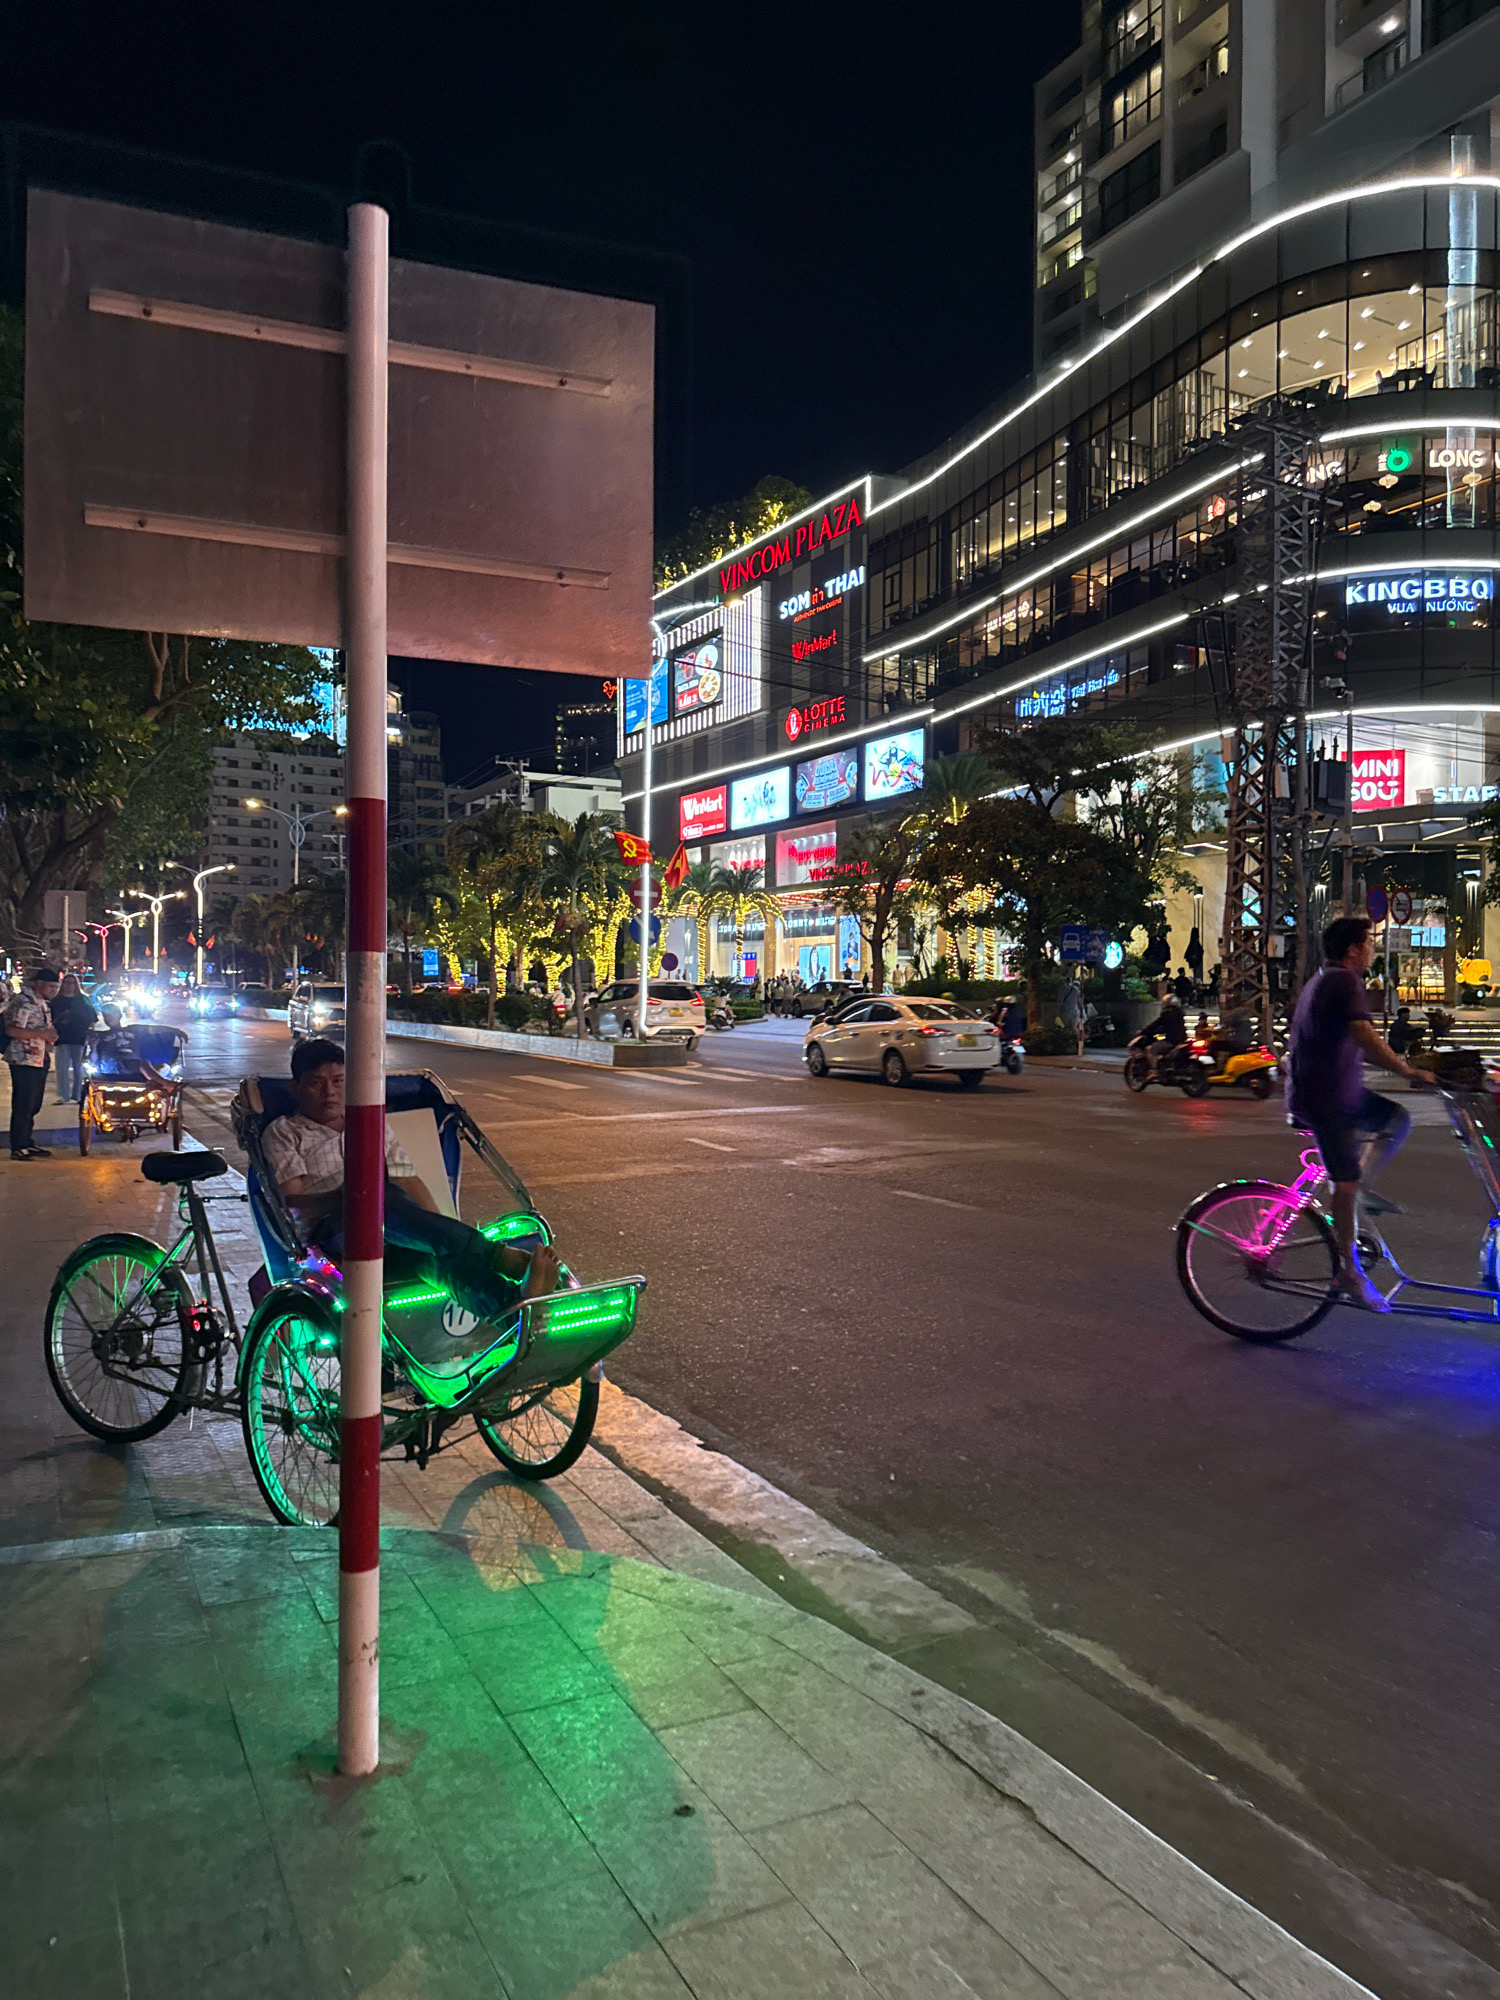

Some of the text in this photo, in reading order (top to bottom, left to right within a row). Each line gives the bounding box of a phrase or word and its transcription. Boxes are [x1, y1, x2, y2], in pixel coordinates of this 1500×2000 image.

[1429, 449, 1484, 469] LONG
[719, 499, 862, 594] VINCOM PLAZA
[780, 590, 811, 620] SOM
[824, 565, 865, 598] THAI
[1346, 578, 1489, 605] KINGBBQ
[1387, 598, 1475, 614] VUA NƯỚNG
[791, 629, 838, 663] WinMart
[804, 695, 846, 720] LOTTE
[804, 713, 846, 733] CINEMA
[1351, 758, 1399, 778] MINI
[683, 793, 723, 821] WinMart
